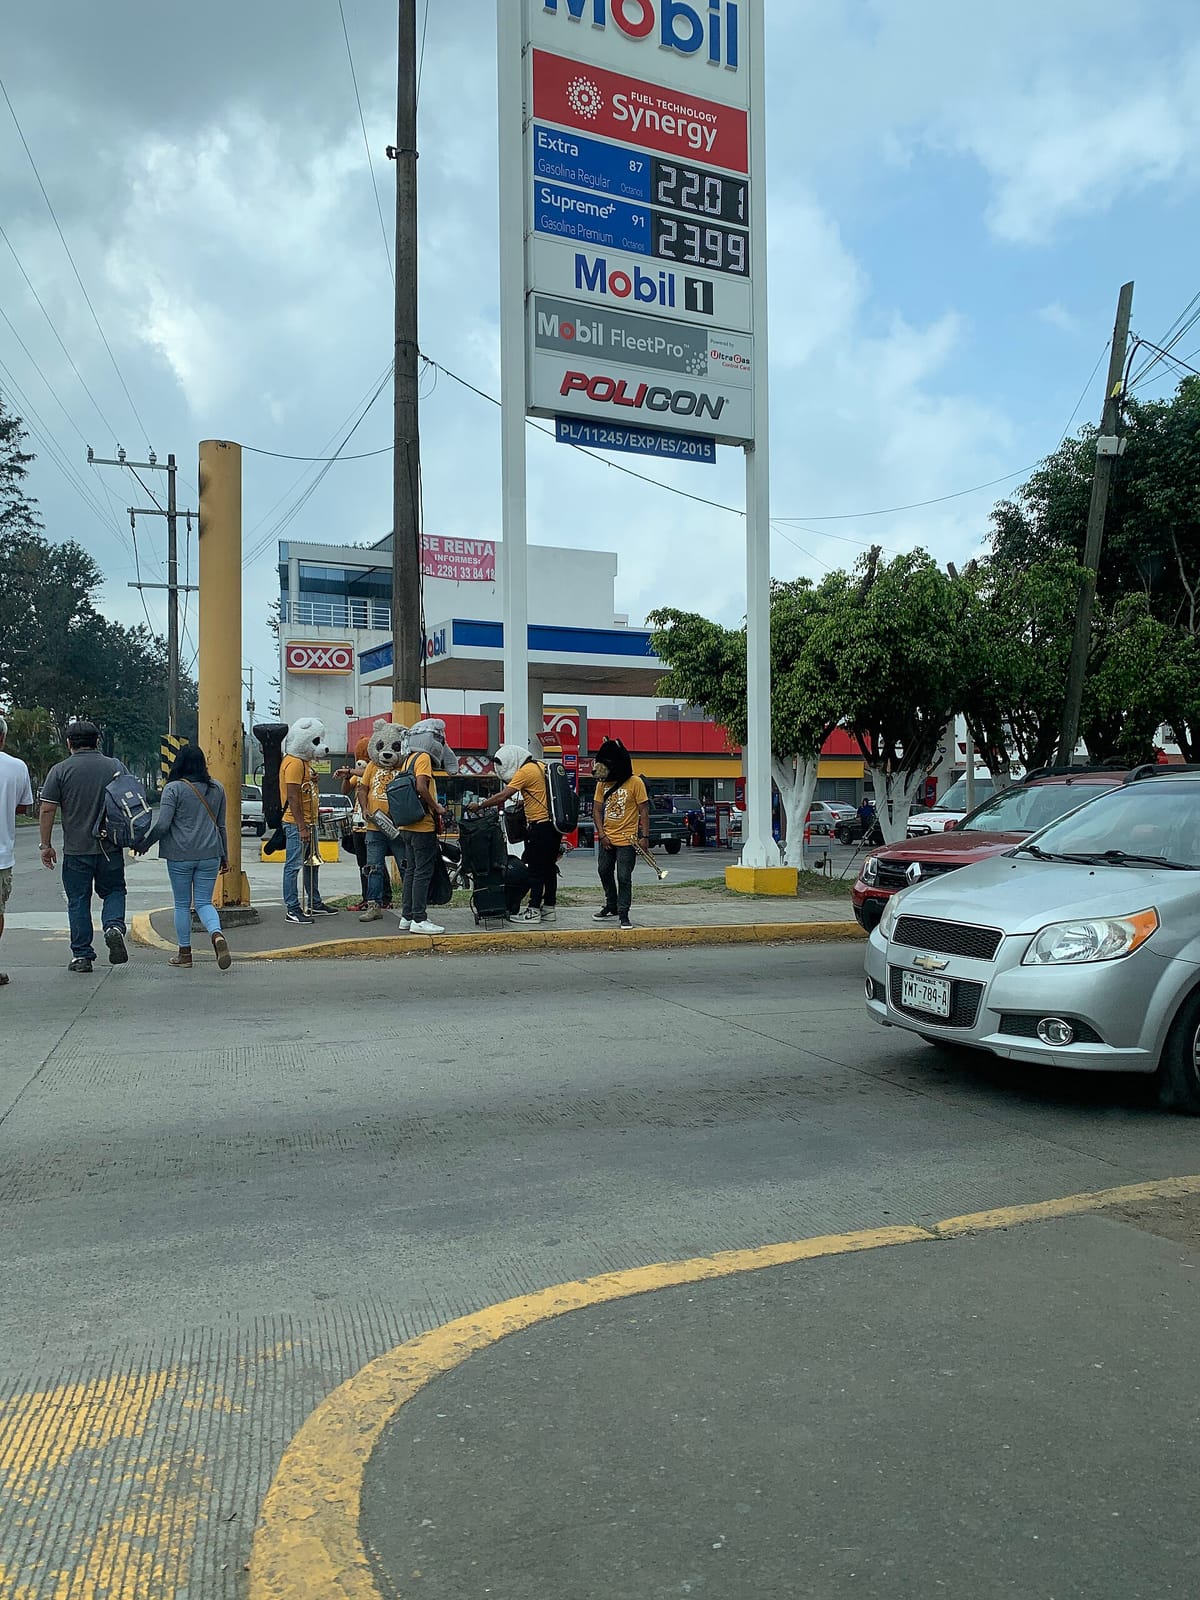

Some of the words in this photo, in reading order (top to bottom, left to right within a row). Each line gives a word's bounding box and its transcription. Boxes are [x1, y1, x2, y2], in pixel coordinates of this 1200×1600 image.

[612, 93, 718, 152] Synergy
[631, 91, 655, 106] FUEL
[656, 98, 718, 124] TECHNOLOGY
[538, 131, 579, 157] Extra
[538, 158, 576, 180] Gasolina
[577, 168, 611, 188] Regular
[629, 160, 643, 174] 87
[540, 214, 576, 236] Gasolina
[577, 223, 614, 245] Premium
[631, 214, 645, 228] 91
[659, 218, 745, 272] 23.99
[575, 253, 676, 308] Mobil
[537, 311, 604, 346] Mobil
[560, 423, 712, 458] PL/11245/EXP/ES/2015
[420, 536, 440, 552] SE
[443, 539, 494, 556] RENTA
[434, 553, 481, 565] INFORMES:
[437, 564, 458, 578] 2281
[460, 566, 471, 579] 33
[290, 647, 350, 669] OXXO
[423, 628, 447, 659] obil
